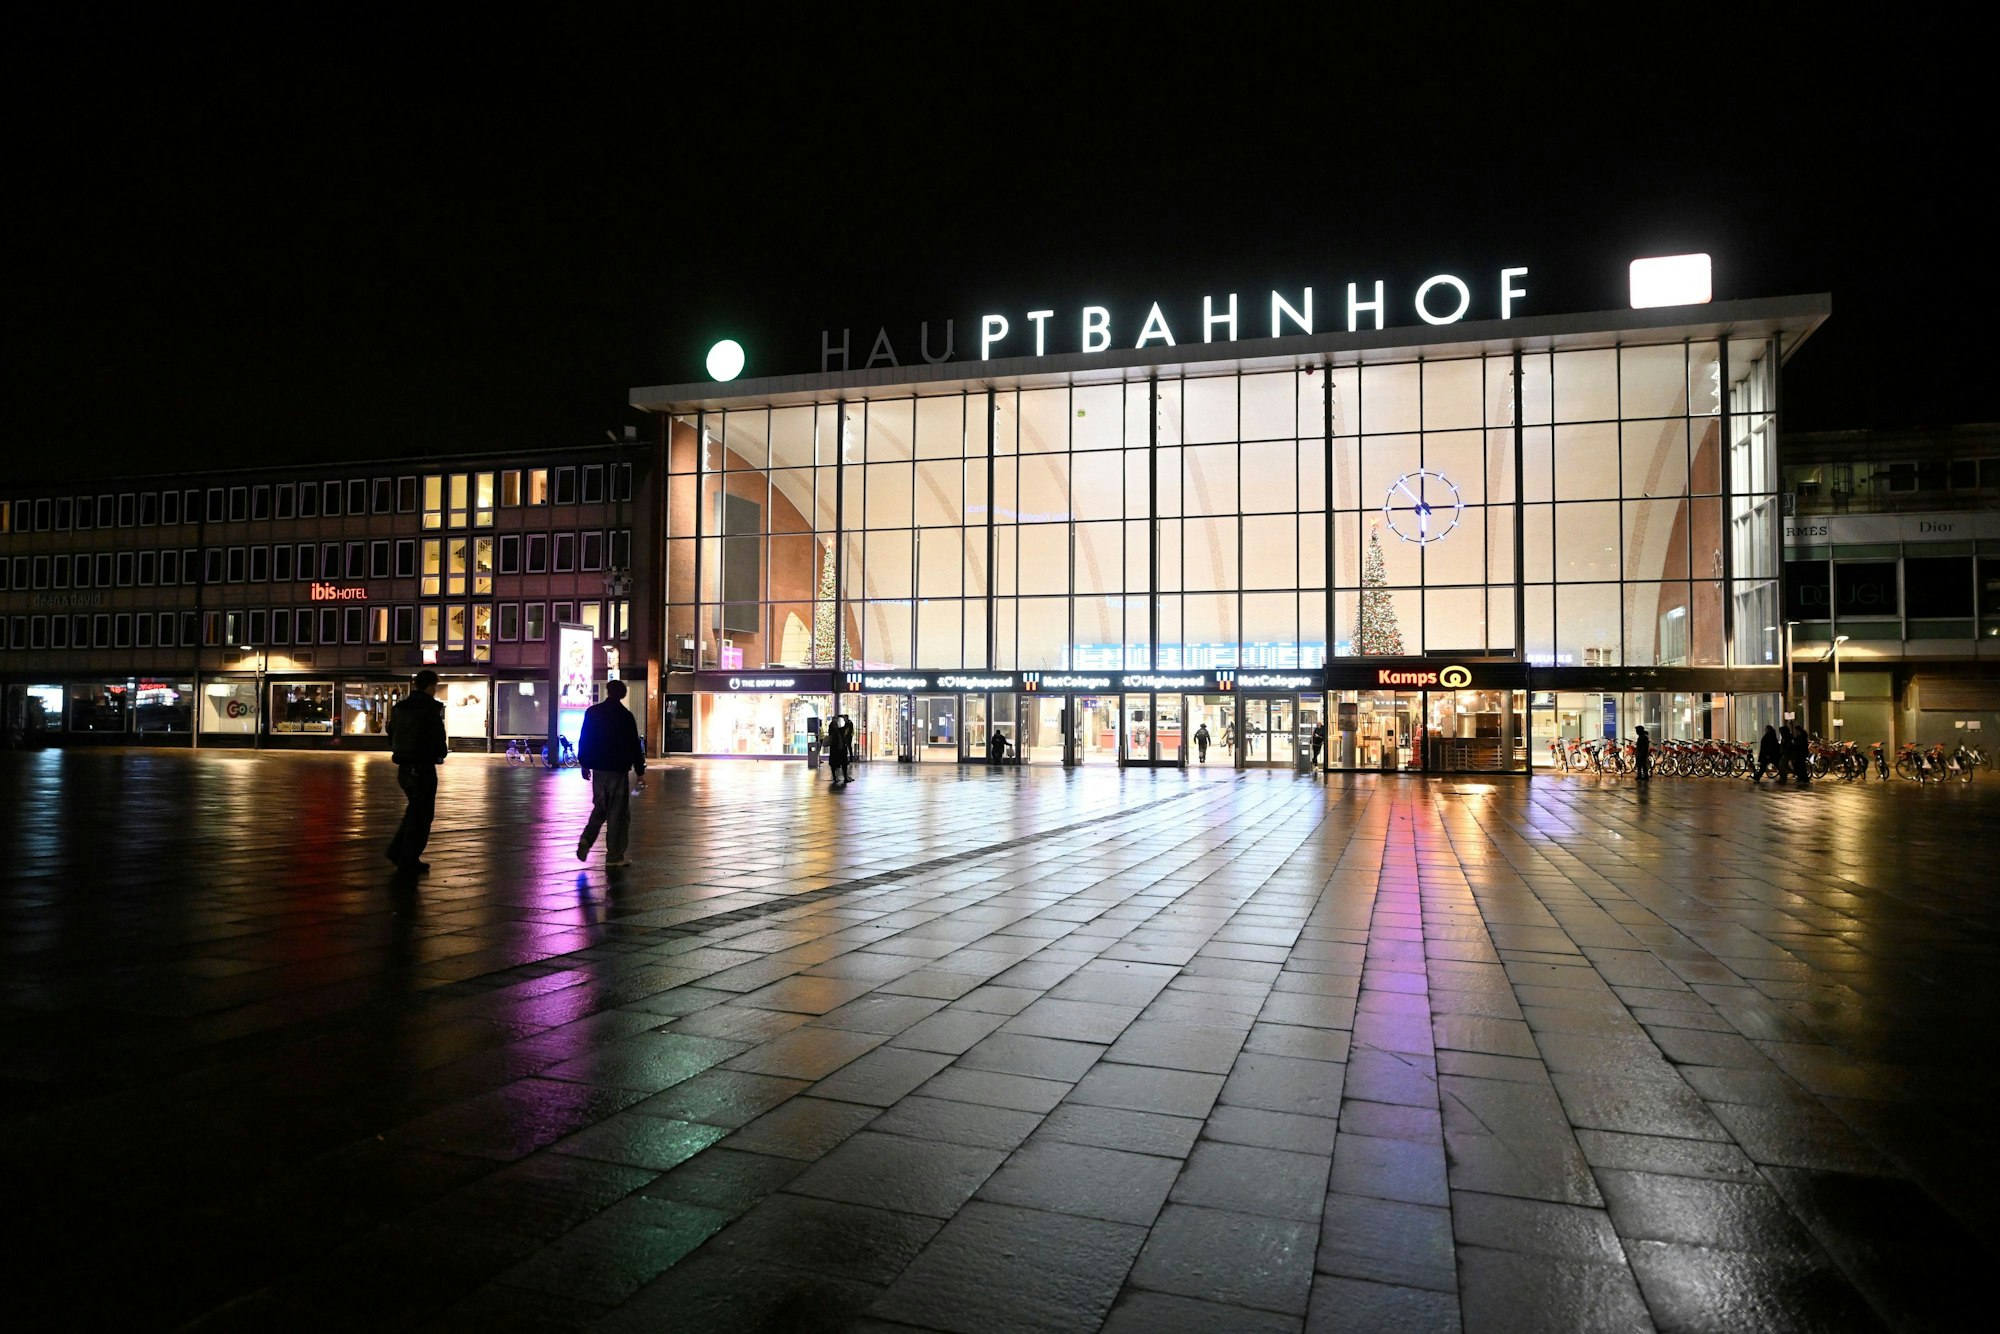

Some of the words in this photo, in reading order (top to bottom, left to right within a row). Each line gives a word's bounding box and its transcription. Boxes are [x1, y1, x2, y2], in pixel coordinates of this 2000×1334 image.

[820, 267, 1528, 372] HAUPTBAHNHOF
[1786, 525, 1828, 536] RMÈS
[1919, 521, 1954, 532] Dior
[311, 582, 336, 600] ibis
[337, 588, 367, 599] HOTEL
[741, 679, 755, 687] THE
[756, 679, 775, 687] BODY
[775, 679, 795, 687] SHOP
[865, 676, 927, 689] NetCologne
[1043, 676, 1111, 689] NetCologne
[1238, 675, 1312, 688] NetCologne
[1379, 670, 1437, 687] Kamps
